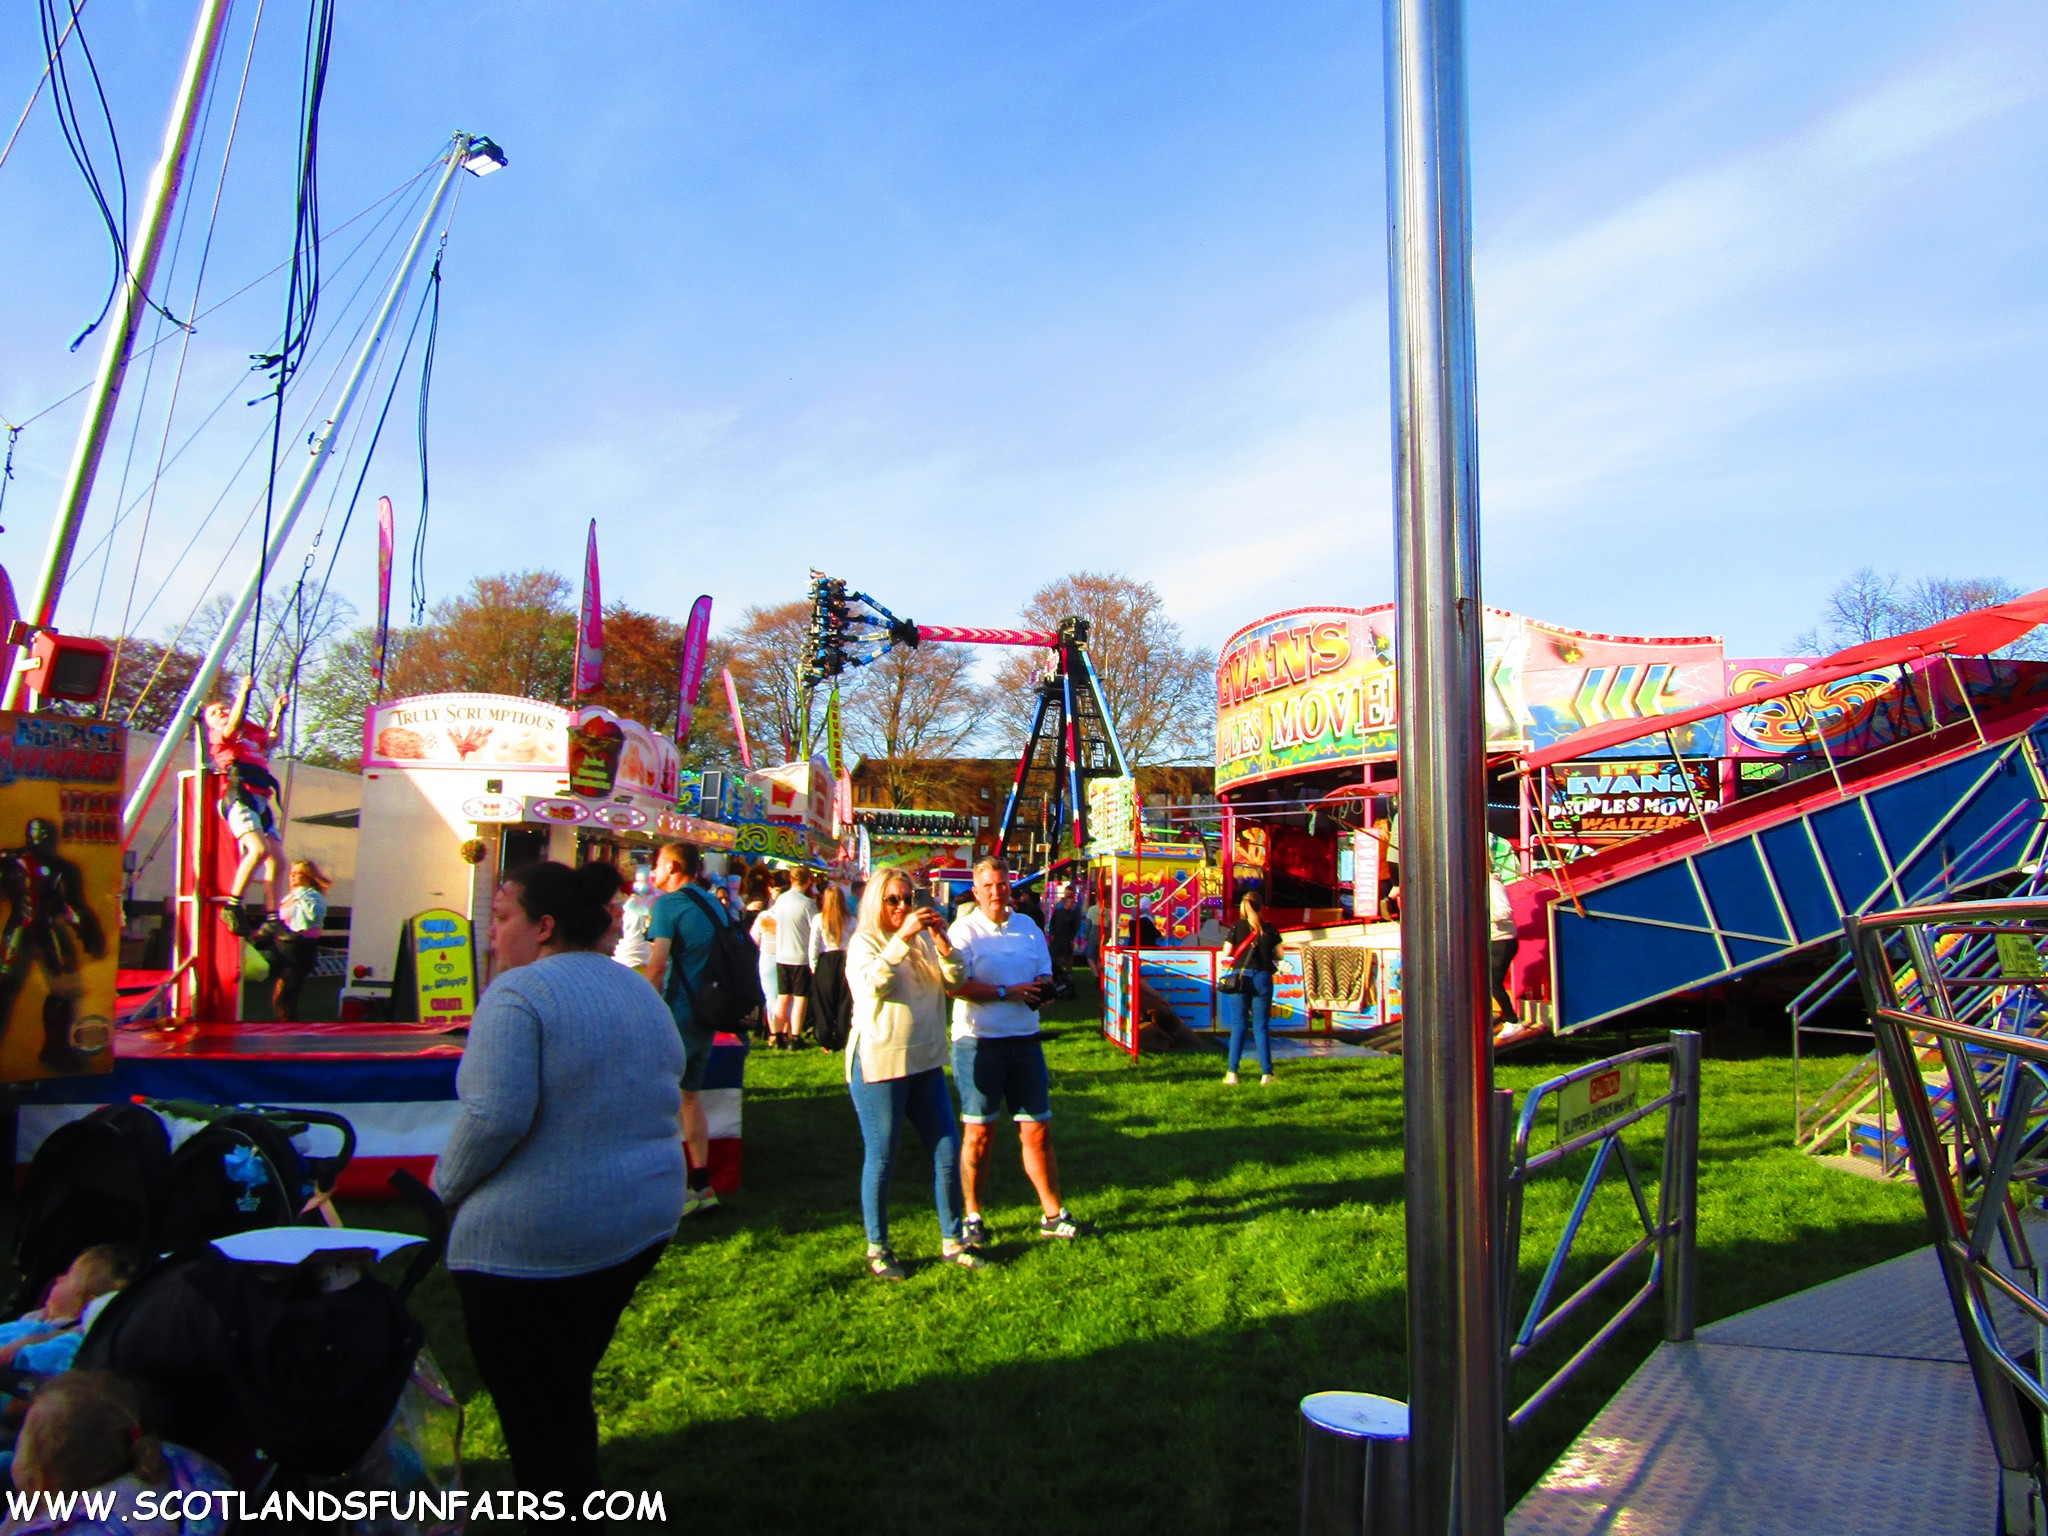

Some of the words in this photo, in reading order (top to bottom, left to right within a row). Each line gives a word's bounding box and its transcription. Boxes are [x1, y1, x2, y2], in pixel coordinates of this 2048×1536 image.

[1219, 620, 1351, 706] EVANS
[389, 709, 440, 727] TRULY
[445, 703, 556, 731] SCRUMPTIOUS
[831, 711, 842, 779] BURGERS
[1217, 708, 1263, 766] PLES
[1600, 763, 1661, 776] IT'S
[1566, 773, 1697, 795] EVANS
[1547, 796, 1641, 820] PEOPLES
[1581, 816, 1685, 830] WALTZER
